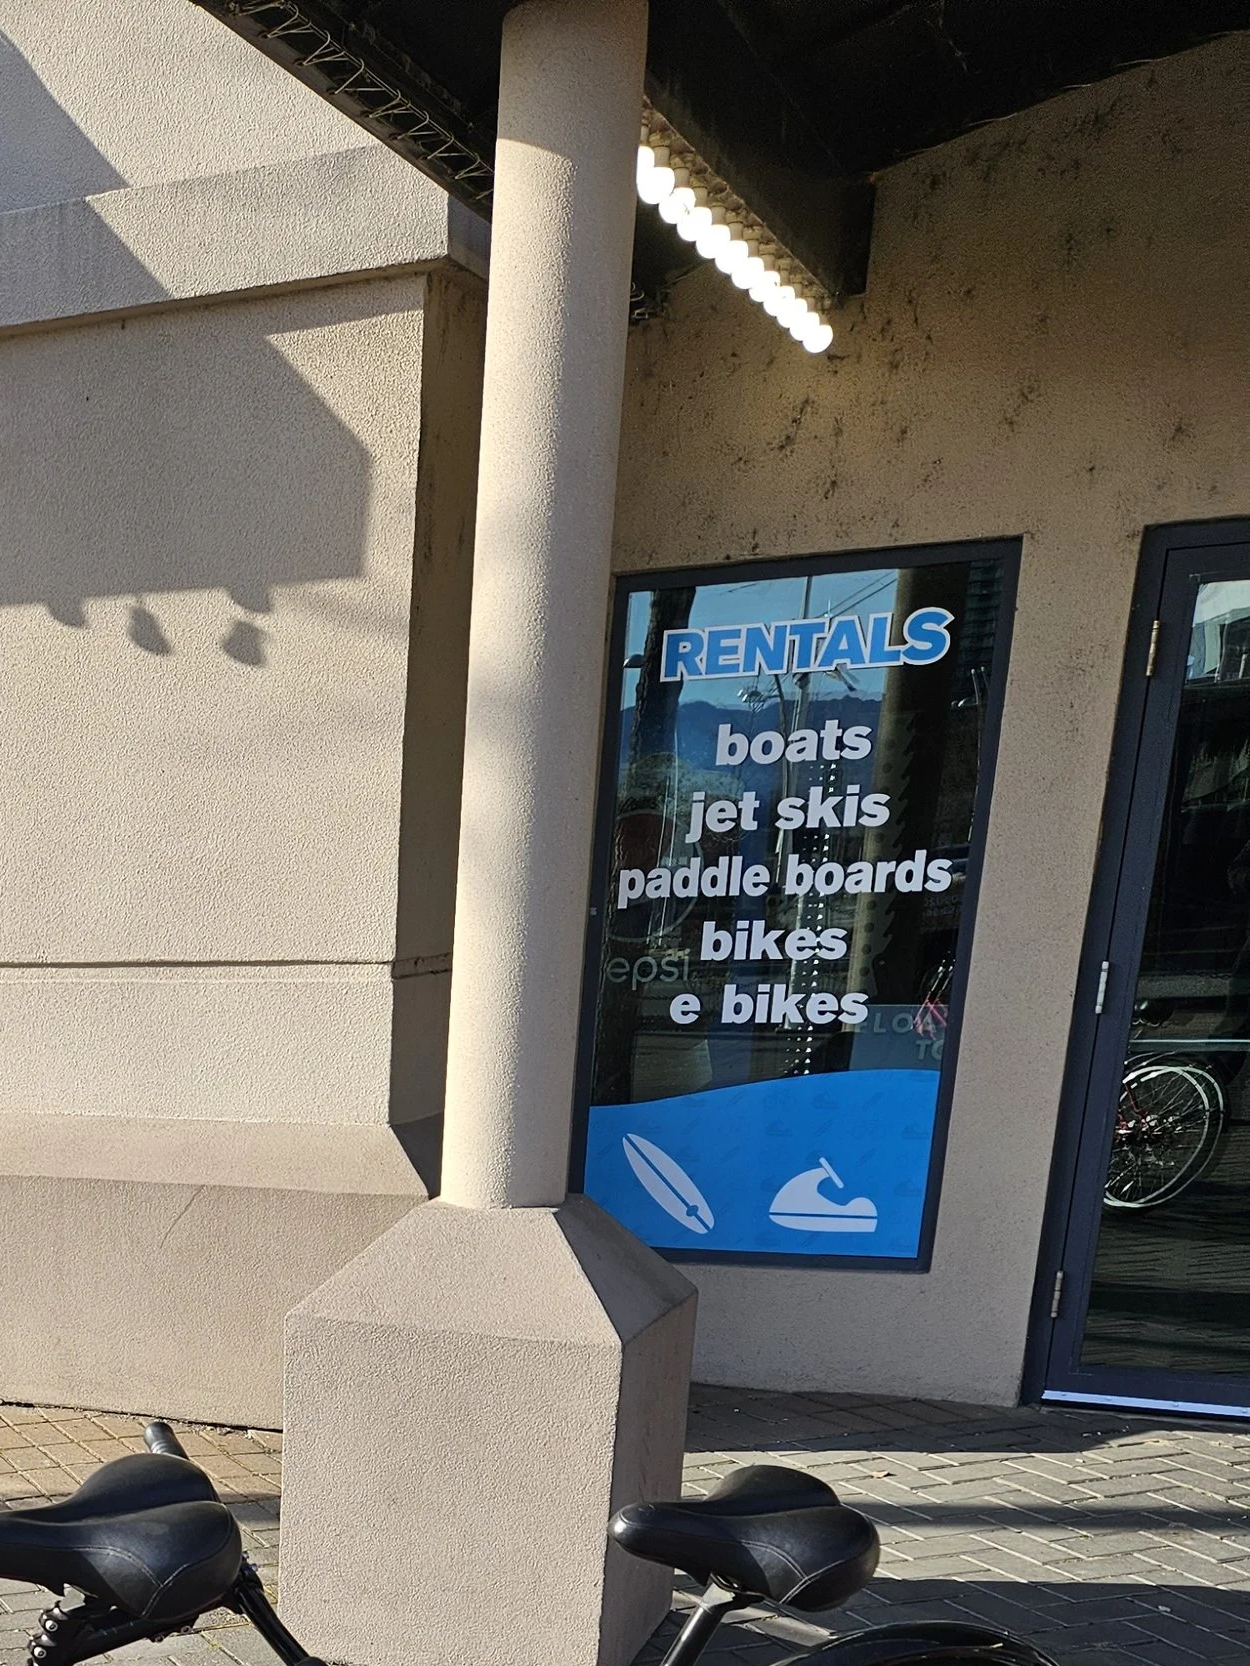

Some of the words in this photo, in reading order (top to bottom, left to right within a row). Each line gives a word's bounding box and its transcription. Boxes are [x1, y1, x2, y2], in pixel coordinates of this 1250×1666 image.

[659, 606, 955, 683] RENTALS
[715, 719, 873, 766] boats
[684, 791, 760, 843] jet
[775, 784, 891, 830] skis
[617, 855, 770, 910] paddle
[785, 849, 953, 896] boards
[700, 920, 848, 961] bikes
[669, 993, 701, 1025] e
[721, 984, 870, 1025] bikes
